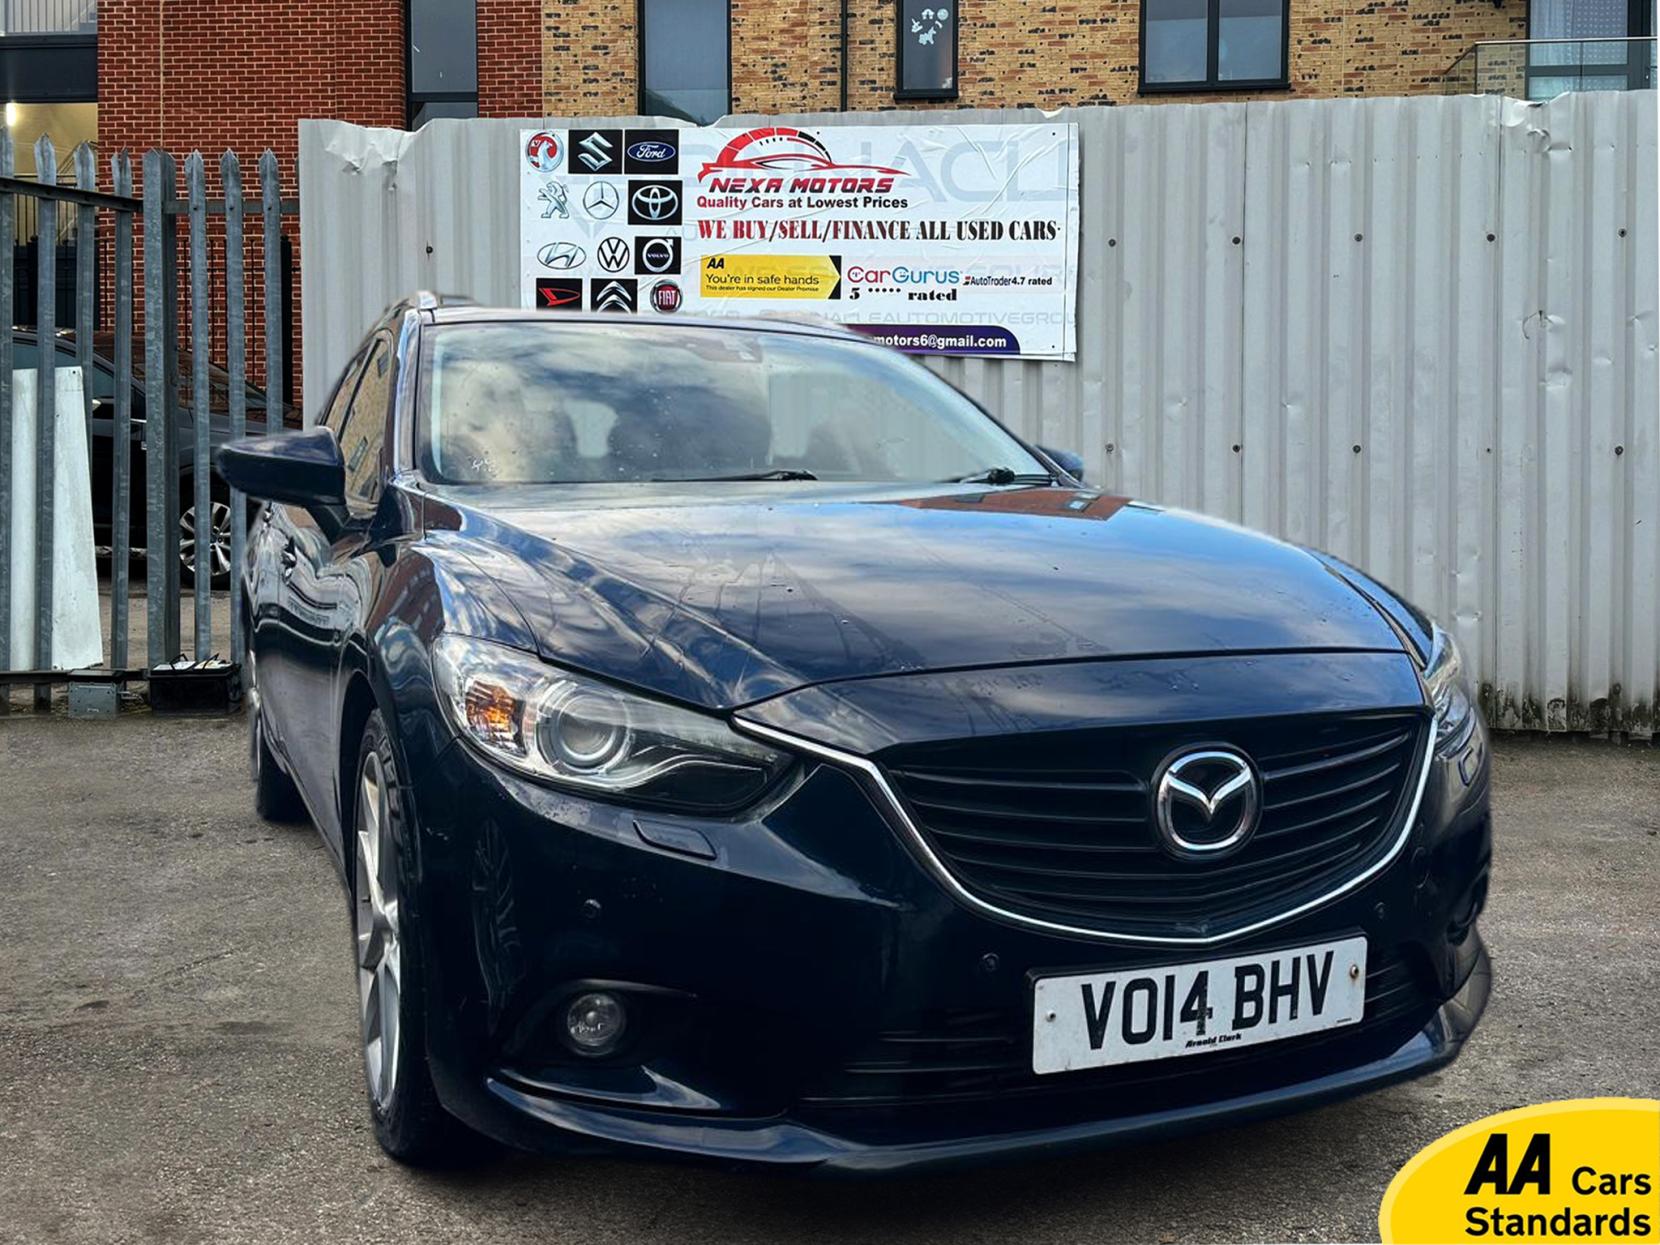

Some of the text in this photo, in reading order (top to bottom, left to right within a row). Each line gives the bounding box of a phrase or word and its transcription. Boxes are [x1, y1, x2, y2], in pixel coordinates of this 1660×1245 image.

[636, 143, 666, 159] Ford
[709, 178, 894, 193] NEXA MOTORS
[697, 196, 908, 210] Quality Cars at Lowest Prices
[698, 220, 727, 240] WE
[916, 220, 950, 240] ALL
[957, 220, 1004, 240] USED
[1009, 220, 1057, 240] CARS
[706, 257, 725, 269] AA
[706, 273, 820, 285] You're in safe hands
[847, 266, 960, 284] CarGurus
[1028, 277, 1053, 286] rated
[657, 289, 677, 306] FIAT
[849, 287, 958, 301] 5 rated
[871, 334, 1007, 350] motors6@gmail.com
[1081, 950, 1334, 1050] VO14 BHV
